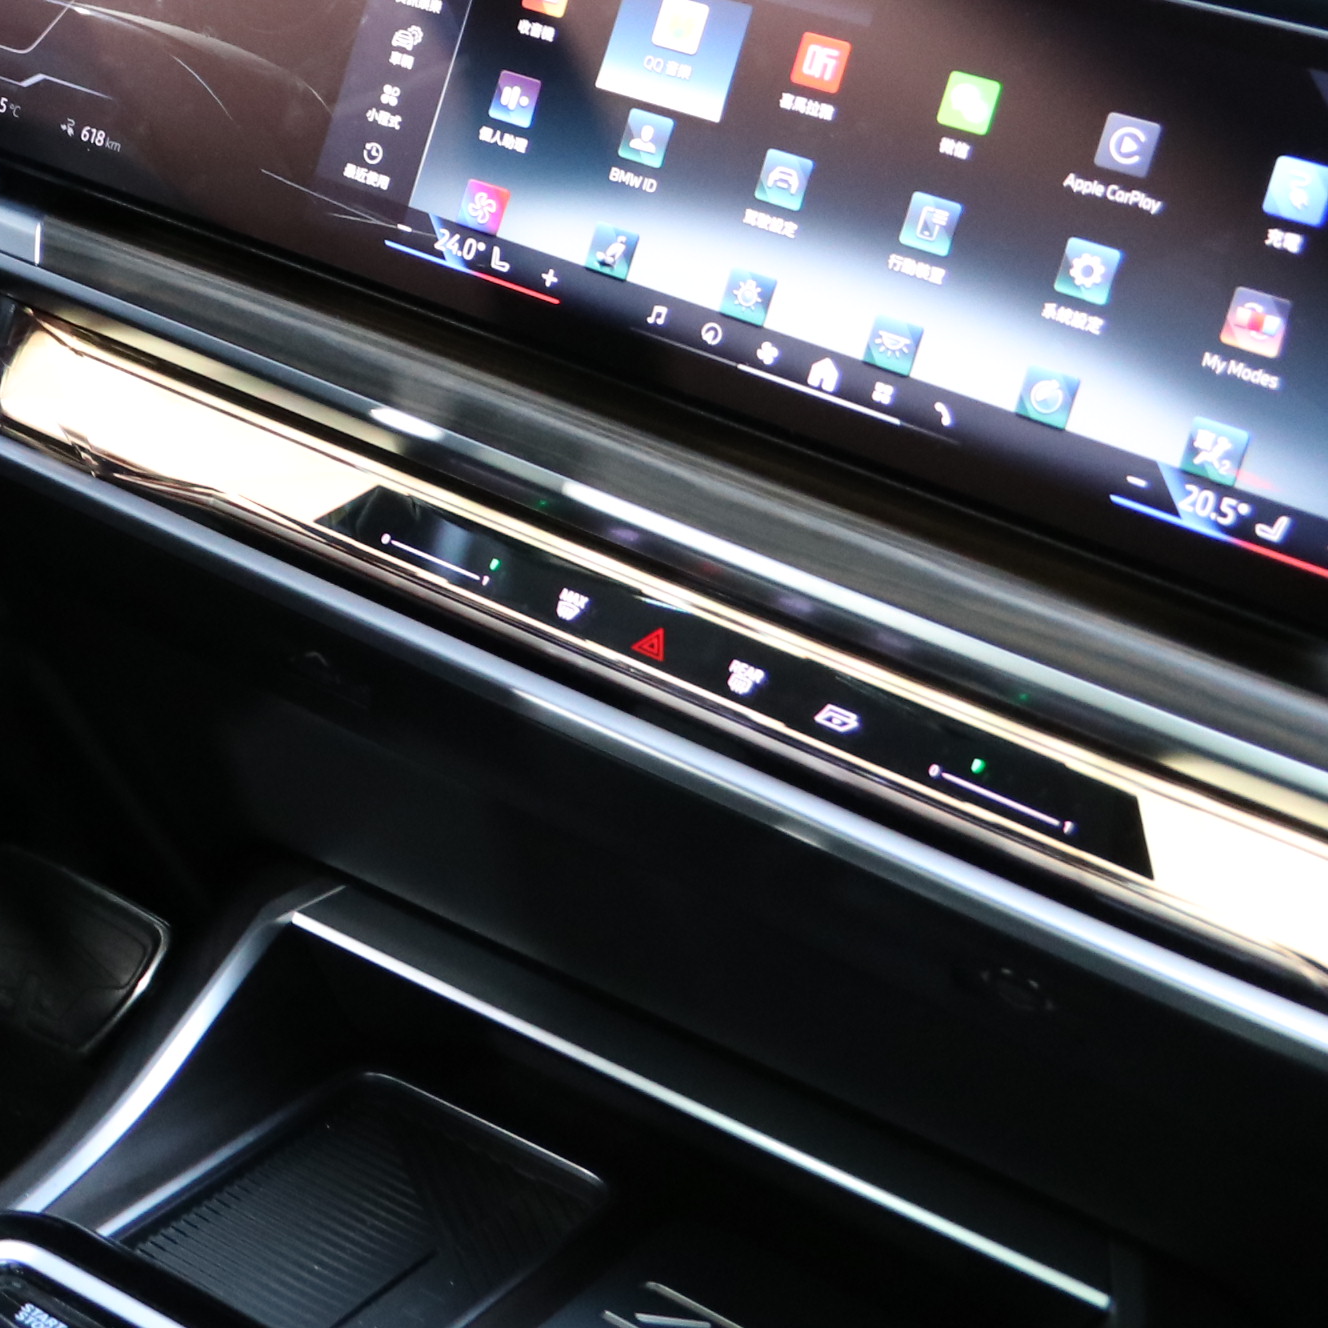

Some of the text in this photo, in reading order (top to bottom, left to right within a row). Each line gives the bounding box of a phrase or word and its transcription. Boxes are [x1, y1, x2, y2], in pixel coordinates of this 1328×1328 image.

[517, 19, 557, 43] 收音機
[643, 55, 665, 73] QQ
[366, 107, 402, 131] 小程式
[80, 125, 122, 153] 618 km
[478, 125, 529, 154] 個人助理
[939, 136, 971, 160] 微信
[343, 163, 391, 191] 最近使用
[609, 166, 658, 193] BMW ID
[1062, 172, 1163, 215] Apple CarPlay
[1201, 351, 1280, 390] My Modes
[559, 587, 590, 610] MAX
[728, 658, 765, 684] REAR
[20, 1302, 69, 1328] START
